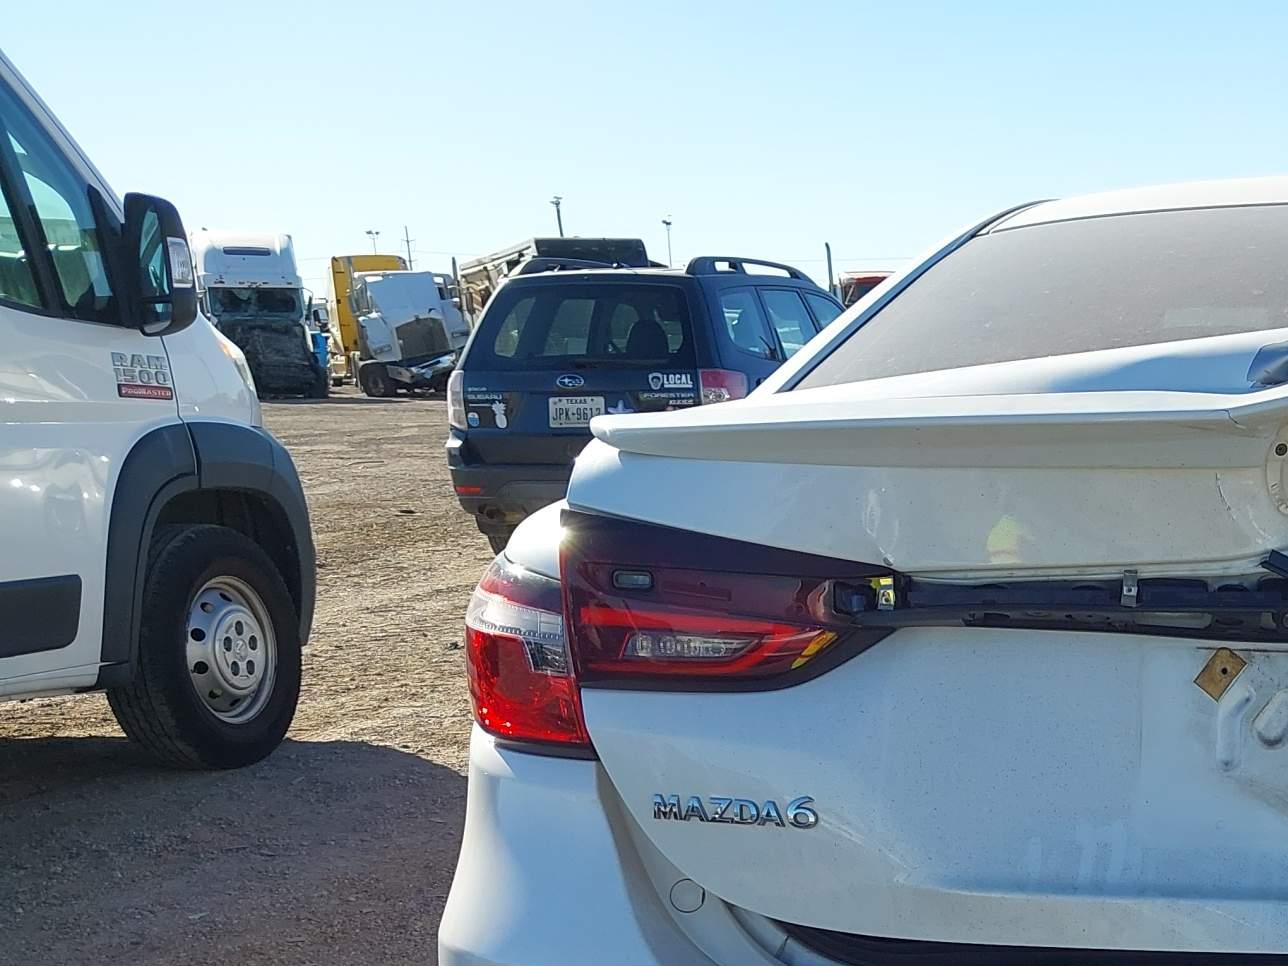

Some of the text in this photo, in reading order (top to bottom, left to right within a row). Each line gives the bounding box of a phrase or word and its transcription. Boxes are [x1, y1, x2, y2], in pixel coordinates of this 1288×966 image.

[111, 352, 168, 370] RAM
[113, 368, 171, 385] 1500
[664, 374, 693, 385] LOCAL
[653, 793, 819, 829] MAZDA6
